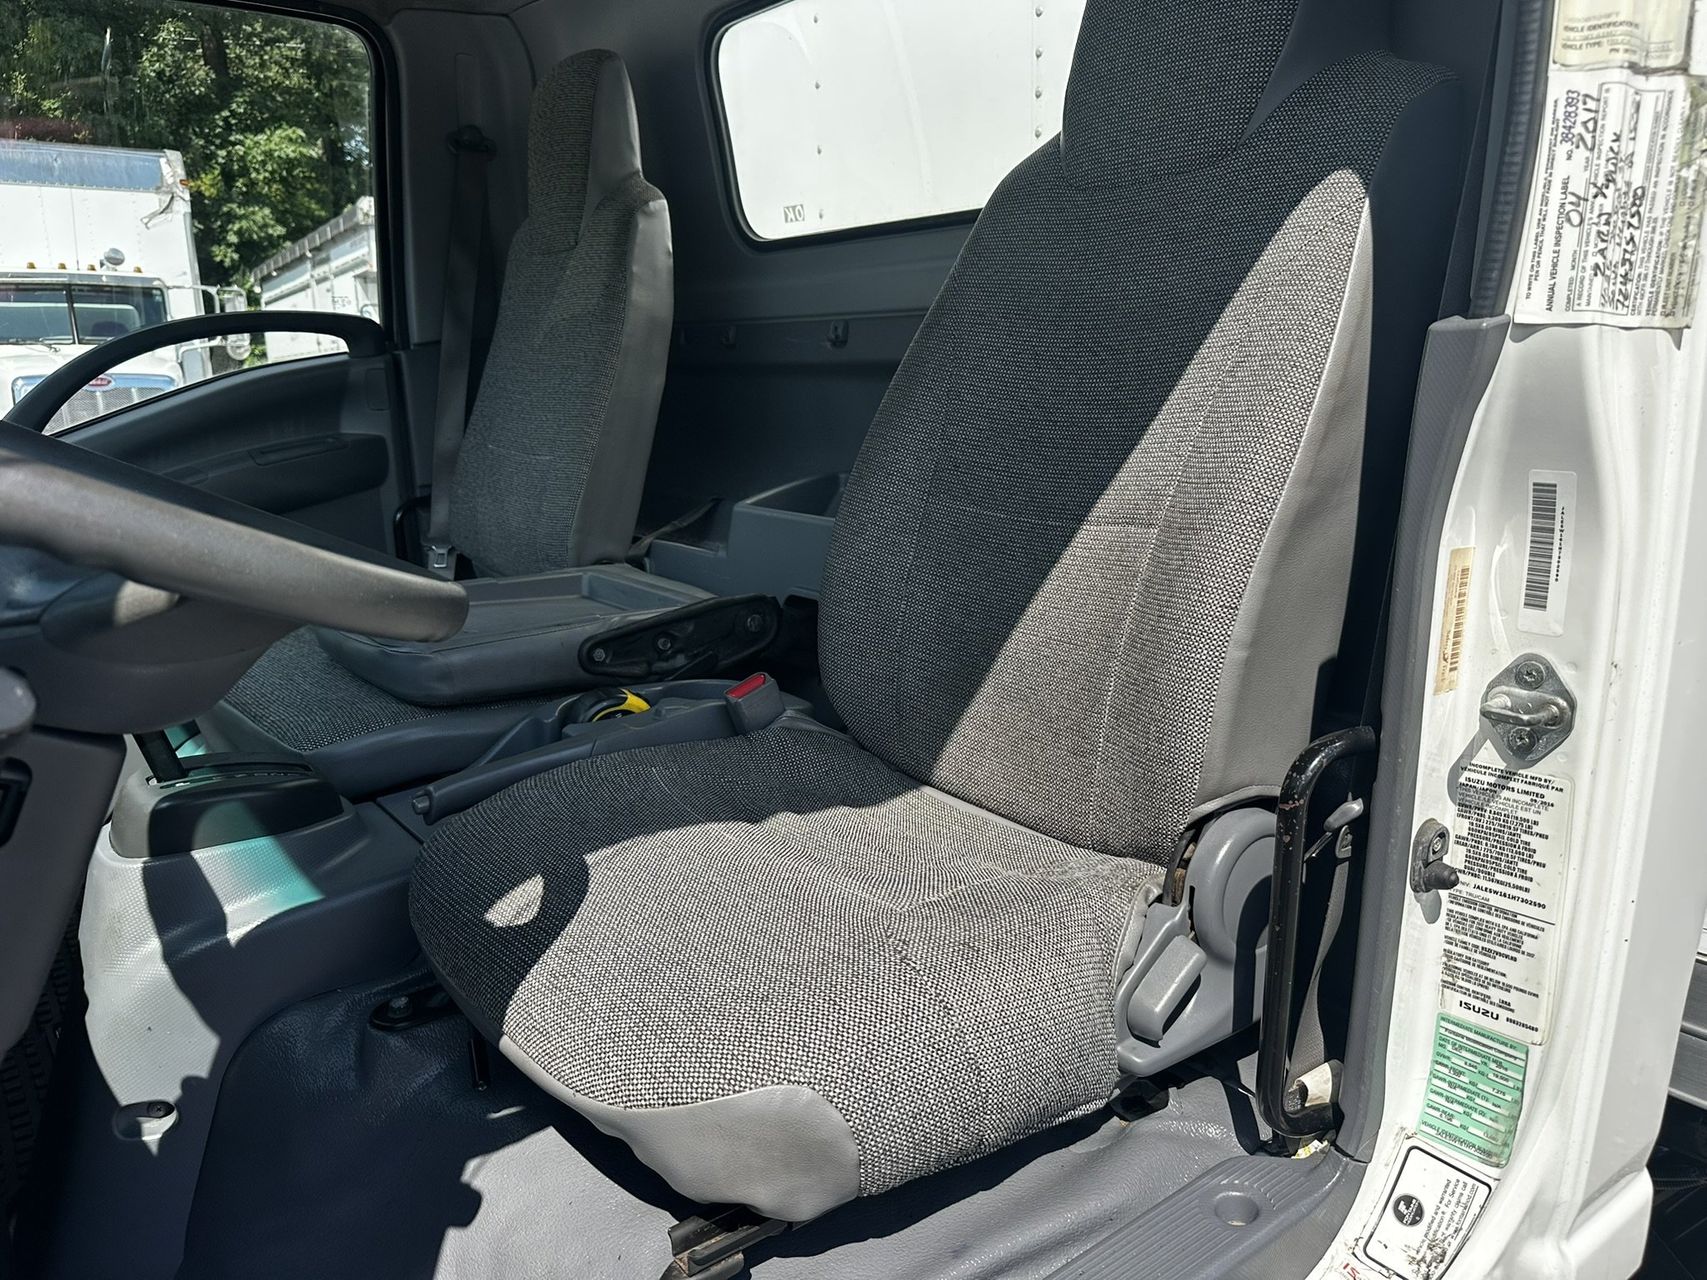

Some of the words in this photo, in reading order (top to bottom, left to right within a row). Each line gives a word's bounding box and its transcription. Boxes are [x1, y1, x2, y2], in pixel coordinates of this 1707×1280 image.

[1560, 90, 1579, 144] 38428393
[1575, 94, 1600, 150] 2017
[1560, 175, 1569, 200] LABEL
[1580, 265, 1586, 273] OF
[1596, 123, 1604, 160] INSPECTION
[1564, 191, 1588, 227] 04
[1554, 202, 1565, 246] INSPECTION
[1525, 291, 1530, 299] TO
[1529, 263, 1534, 272] ON
[1538, 207, 1542, 215] AN
[1535, 260, 1540, 268] OR
[1549, 249, 1560, 280] VEHICLE
[1630, 272, 1641, 315] CERTIFICATION:
[1641, 230, 1649, 253] VEHICLE
[1546, 282, 1555, 311] ANNUAL
[1645, 291, 1653, 315] VEHICLE
[1469, 761, 1503, 773] INCOMPLETE
[1504, 769, 1527, 778] VEHICLE
[1488, 772, 1519, 782] INCOMPLET
[1459, 782, 1496, 794] JAPAN/JAPON
[1465, 777, 1484, 785] ISUZU
[1486, 782, 1514, 792] MOTORS
[1516, 788, 1544, 798] LIMITED
[1475, 789, 1494, 798] VEHICLE
[1512, 799, 1547, 811] INCOMPLETE
[1530, 798, 1553, 807] 09/2016
[1459, 1000, 1498, 1020] ISUZU
[1440, 1016, 1472, 1032] INTERMEDIATE
[1474, 1030, 1508, 1046] MANUFACTURE
[1457, 1044, 1490, 1060] INTERMEDIATE
[1421, 1120, 1440, 1131] VEHICLE
[1439, 1179, 1451, 1204] warranted
[1449, 1178, 1459, 1197] Service
